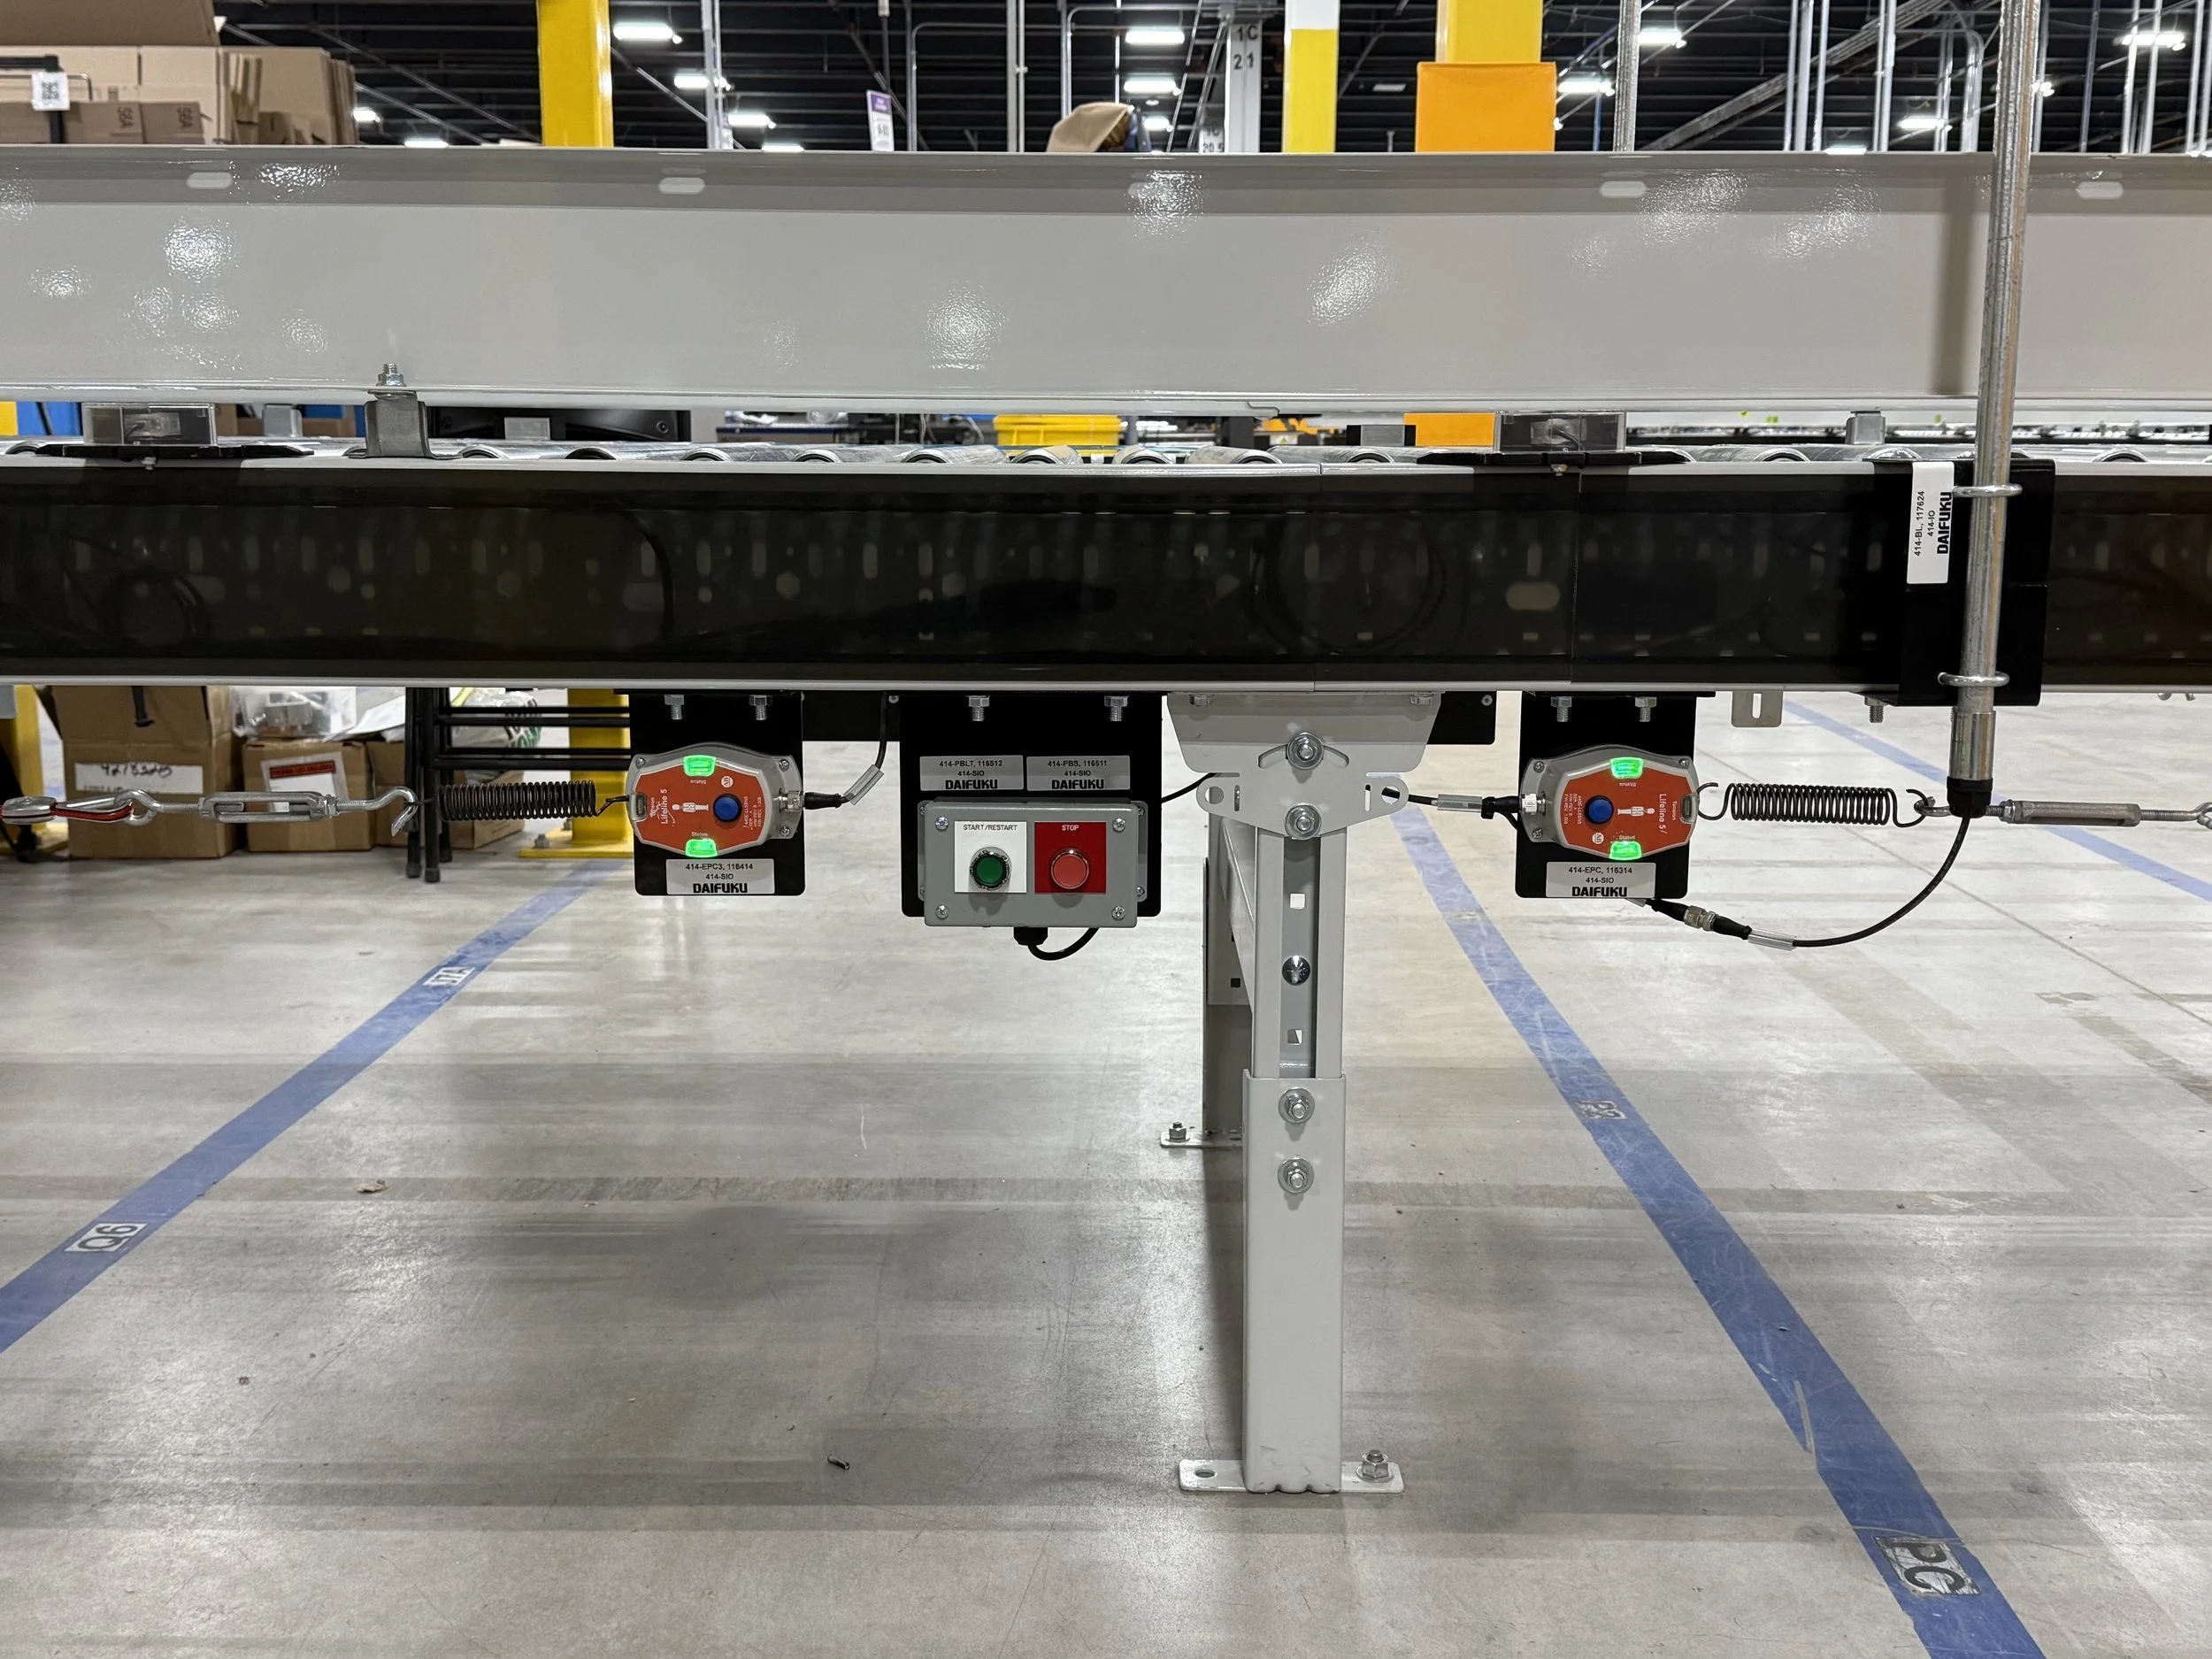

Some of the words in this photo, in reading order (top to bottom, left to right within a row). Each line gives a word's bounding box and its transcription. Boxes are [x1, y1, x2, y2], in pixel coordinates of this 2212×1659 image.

[1916, 490, 1925, 520] 117624
[1927, 510, 1936, 537] 414-IO
[1937, 492, 1952, 555] DAIFUKU
[1914, 524, 1924, 557] 414-BL,
[945, 779, 998, 789] DAIFUKU
[1051, 779, 1104, 789] DAIFUKU
[693, 883, 748, 893] DAIFUKU
[1572, 887, 1627, 897] DAIFUKU
[78, 1225, 139, 1249] Q6
